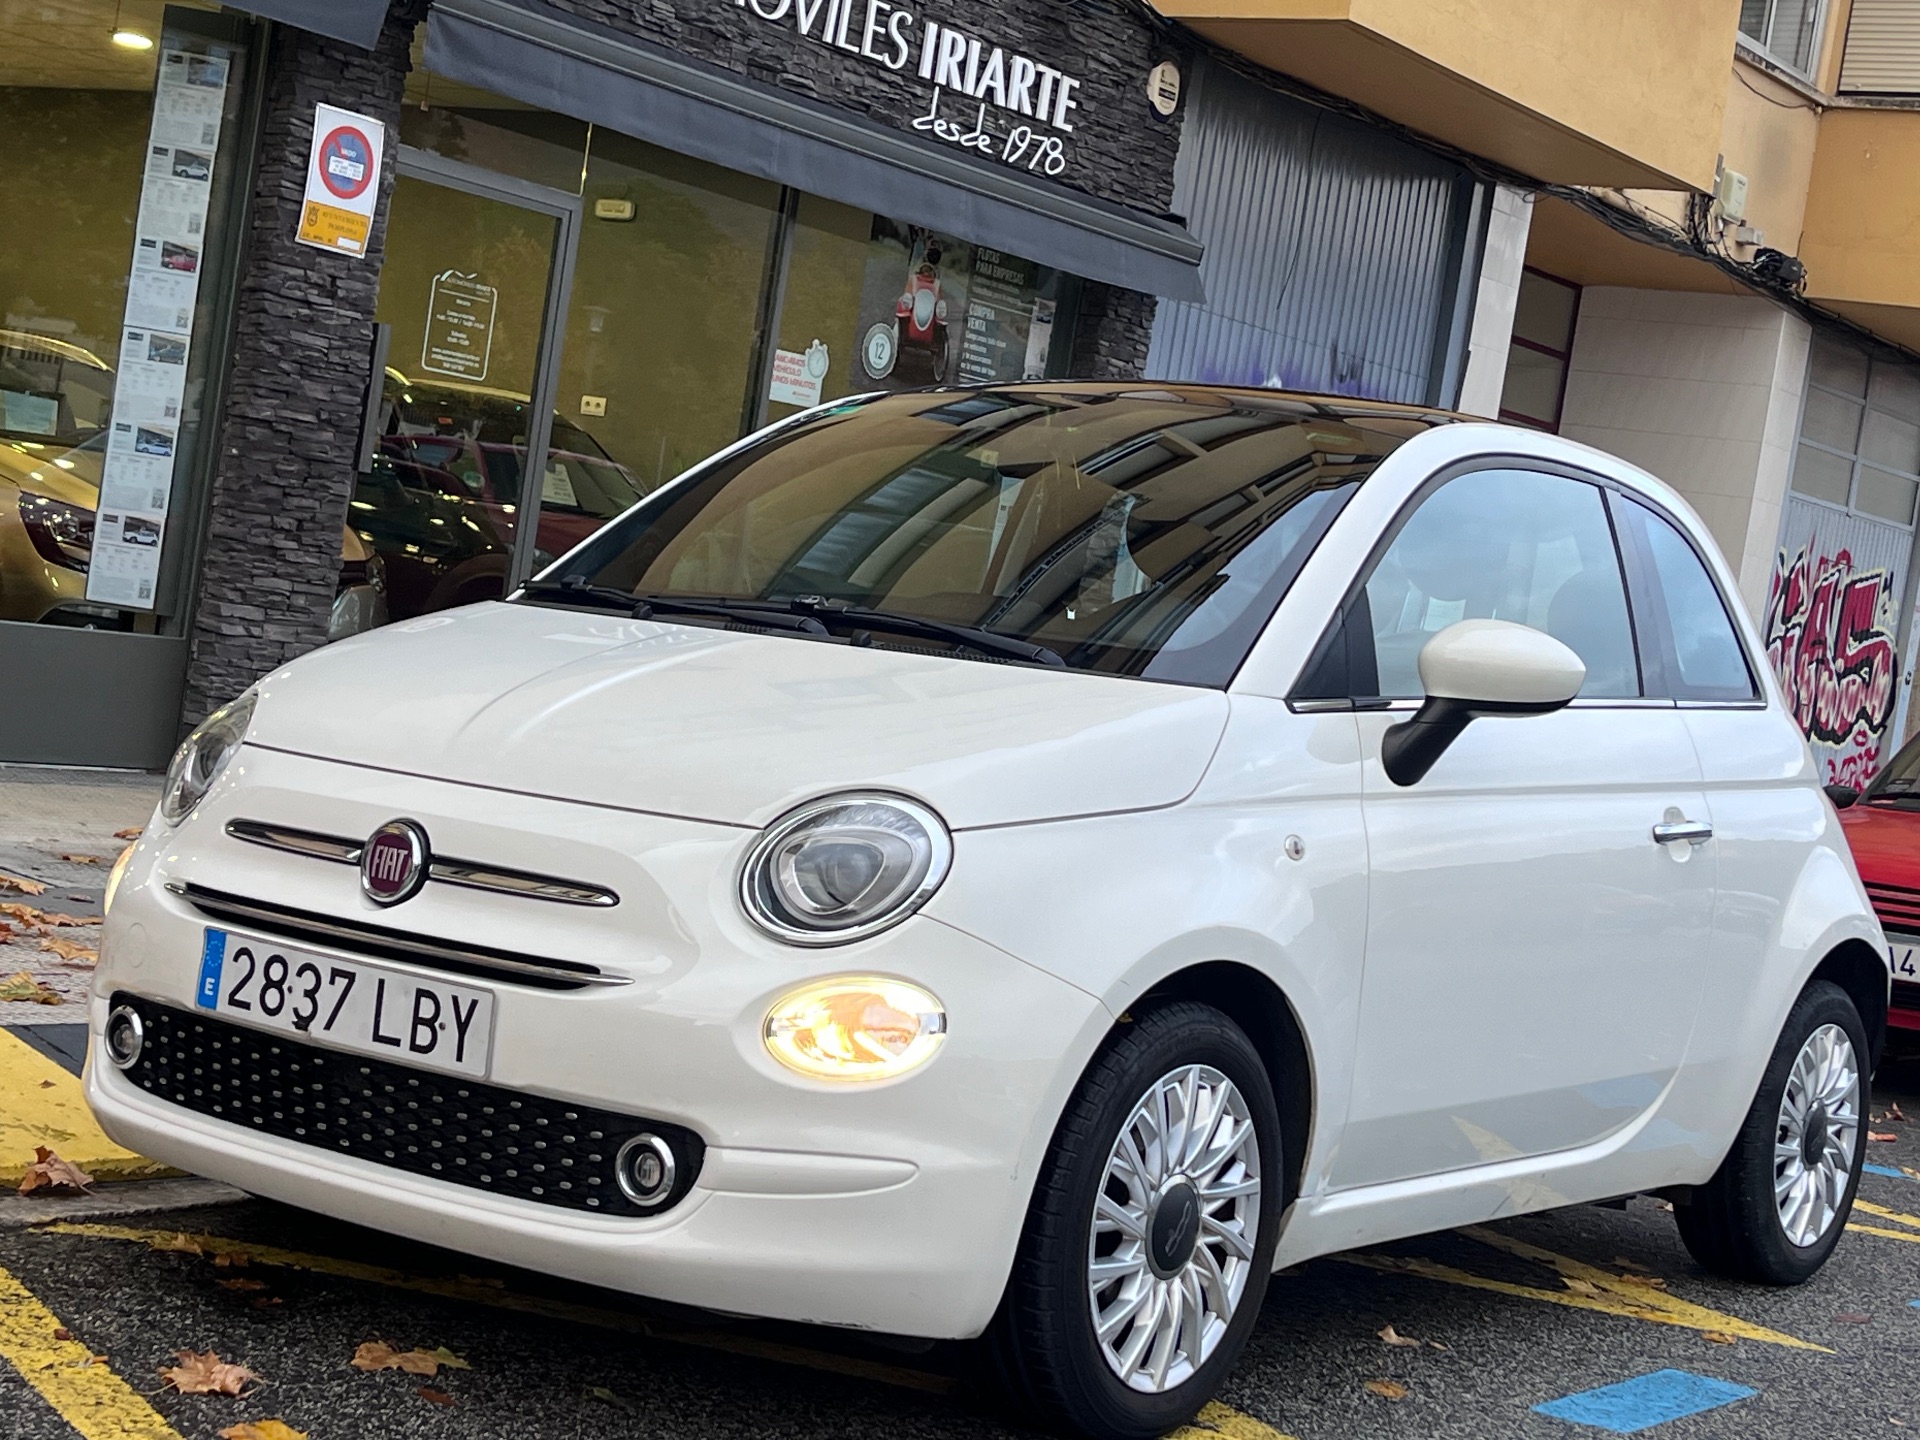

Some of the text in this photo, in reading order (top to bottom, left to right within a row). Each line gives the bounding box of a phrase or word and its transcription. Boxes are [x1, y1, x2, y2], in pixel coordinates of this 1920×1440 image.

[734, 0, 1081, 133] VILES IRIARTE
[912, 86, 1066, 176] desde 1978
[875, 341, 885, 360] 12
[371, 844, 409, 882] FIAT
[203, 977, 216, 996] E
[227, 946, 479, 1062] 2837 LBY
